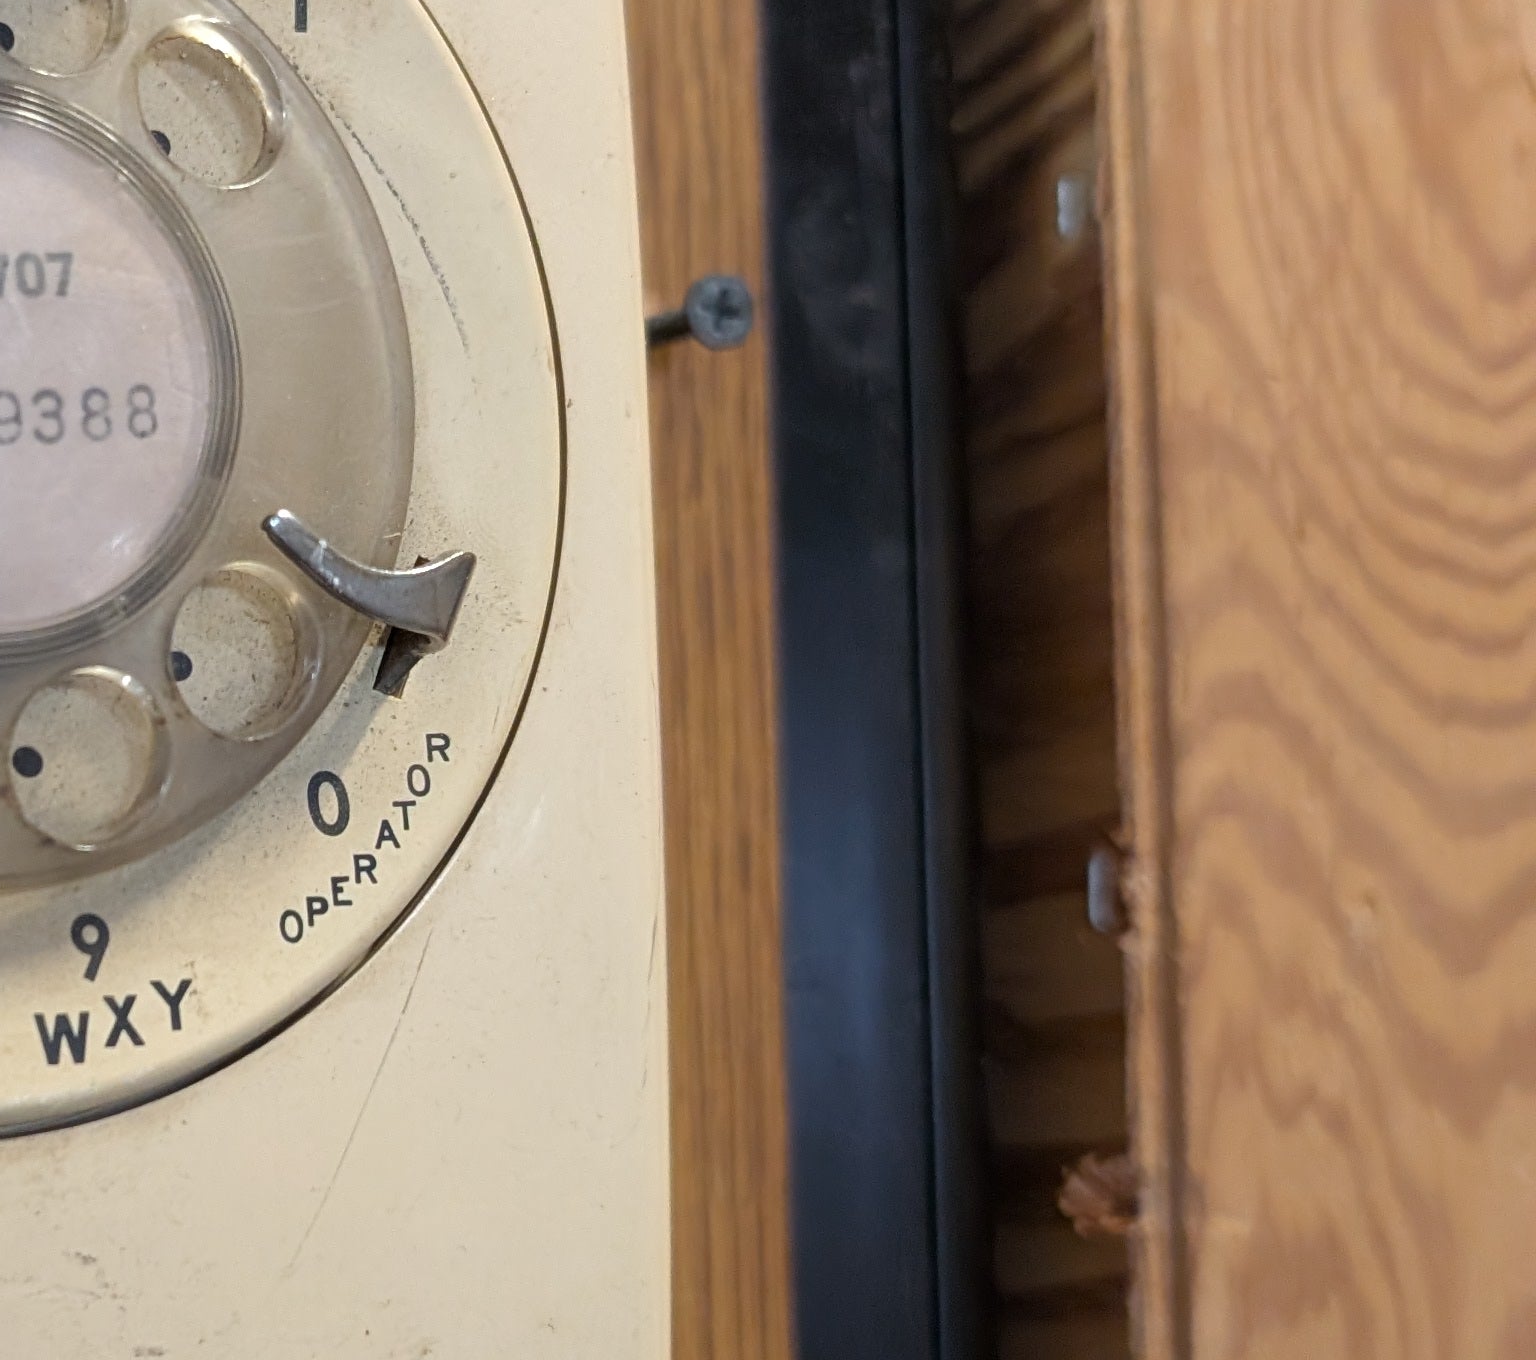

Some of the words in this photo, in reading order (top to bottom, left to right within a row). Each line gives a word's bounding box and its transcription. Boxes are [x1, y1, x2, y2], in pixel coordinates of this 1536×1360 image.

[279, 732, 451, 943] OPERATOR
[70, 912, 110, 982] 9
[34, 978, 192, 1065] WXY
